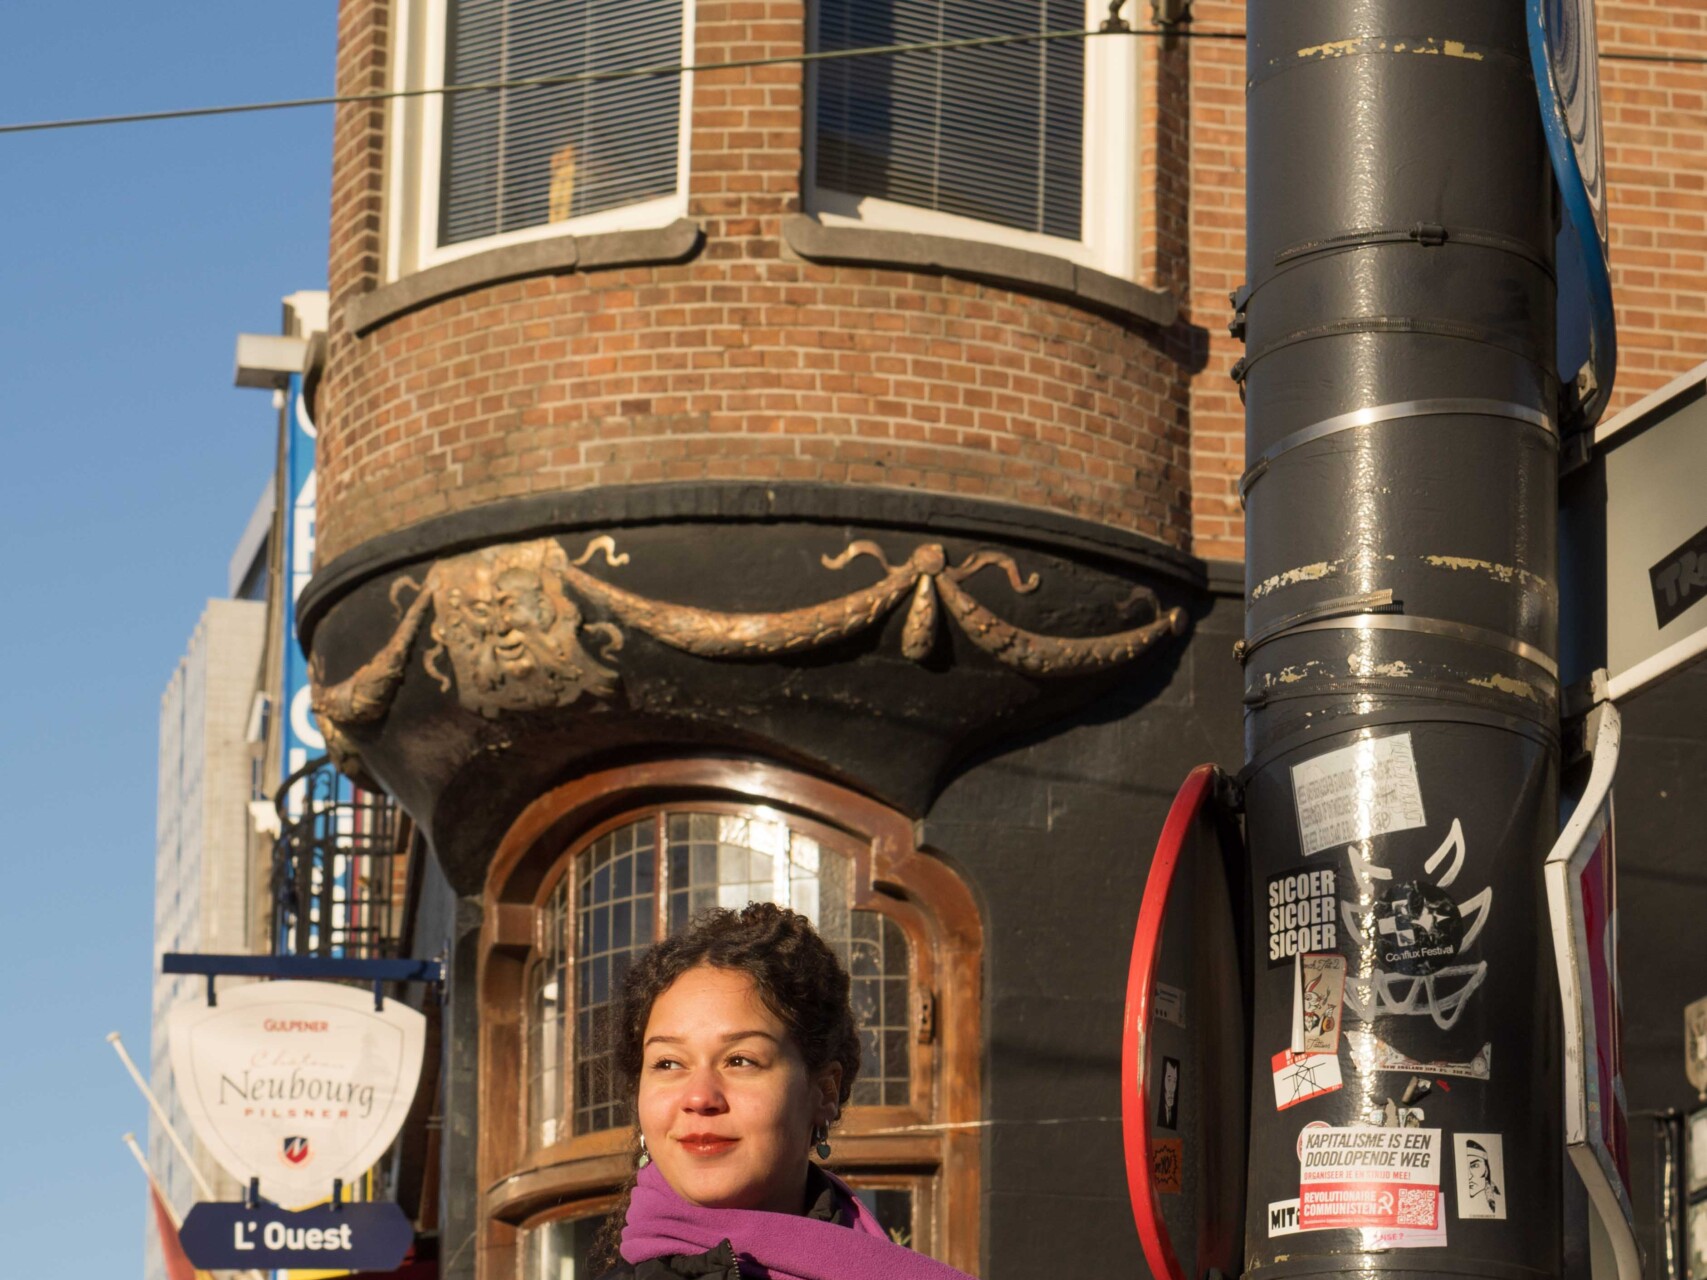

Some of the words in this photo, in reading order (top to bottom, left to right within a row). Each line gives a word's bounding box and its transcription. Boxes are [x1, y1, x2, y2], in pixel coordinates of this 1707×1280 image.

[1269, 870, 1336, 907] SICOER
[1269, 896, 1336, 934] SICOER
[1269, 923, 1337, 960] SICOER
[1385, 950, 1420, 962] Conflux
[1421, 945, 1454, 957] Festival
[263, 1018, 329, 1032] GULPENER
[218, 1068, 375, 1118] Neubourg
[244, 1108, 350, 1118] PILSNER
[1306, 1133, 1388, 1149] KAPITALISME
[1388, 1133, 1402, 1149] IS
[1403, 1134, 1432, 1150] EEN
[1305, 1151, 1398, 1168] DOODLOPENDE
[1400, 1152, 1431, 1168] WEG
[1304, 1170, 1345, 1180] ORGANISEER
[1354, 1170, 1365, 1179] EN
[1392, 1171, 1411, 1180] MEE!
[1304, 1190, 1377, 1203] REVOLUTIONAIRE
[1304, 1202, 1377, 1217] COMMUNISTEN
[263, 1222, 352, 1250] Ouest
